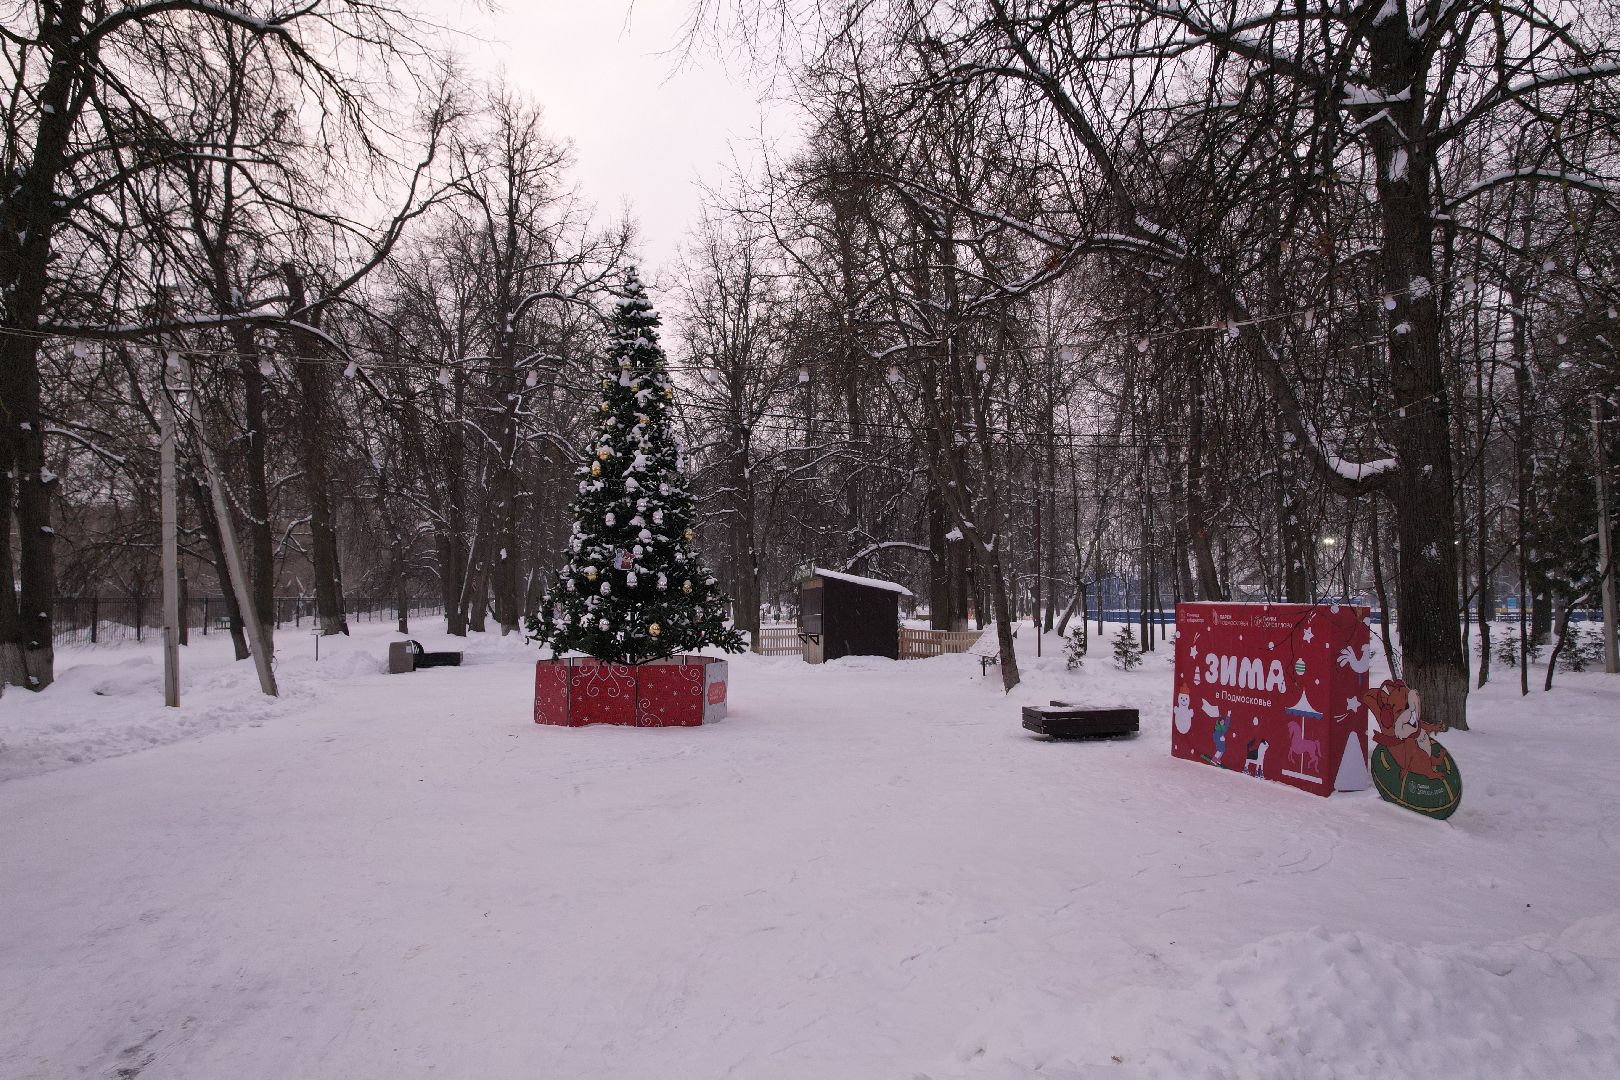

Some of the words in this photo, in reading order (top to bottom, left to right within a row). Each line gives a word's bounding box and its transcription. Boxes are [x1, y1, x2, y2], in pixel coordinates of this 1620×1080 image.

[1205, 653, 1287, 693] ЗИМА
[1215, 691, 1220, 699] в
[1221, 690, 1272, 707] Подмосковье
